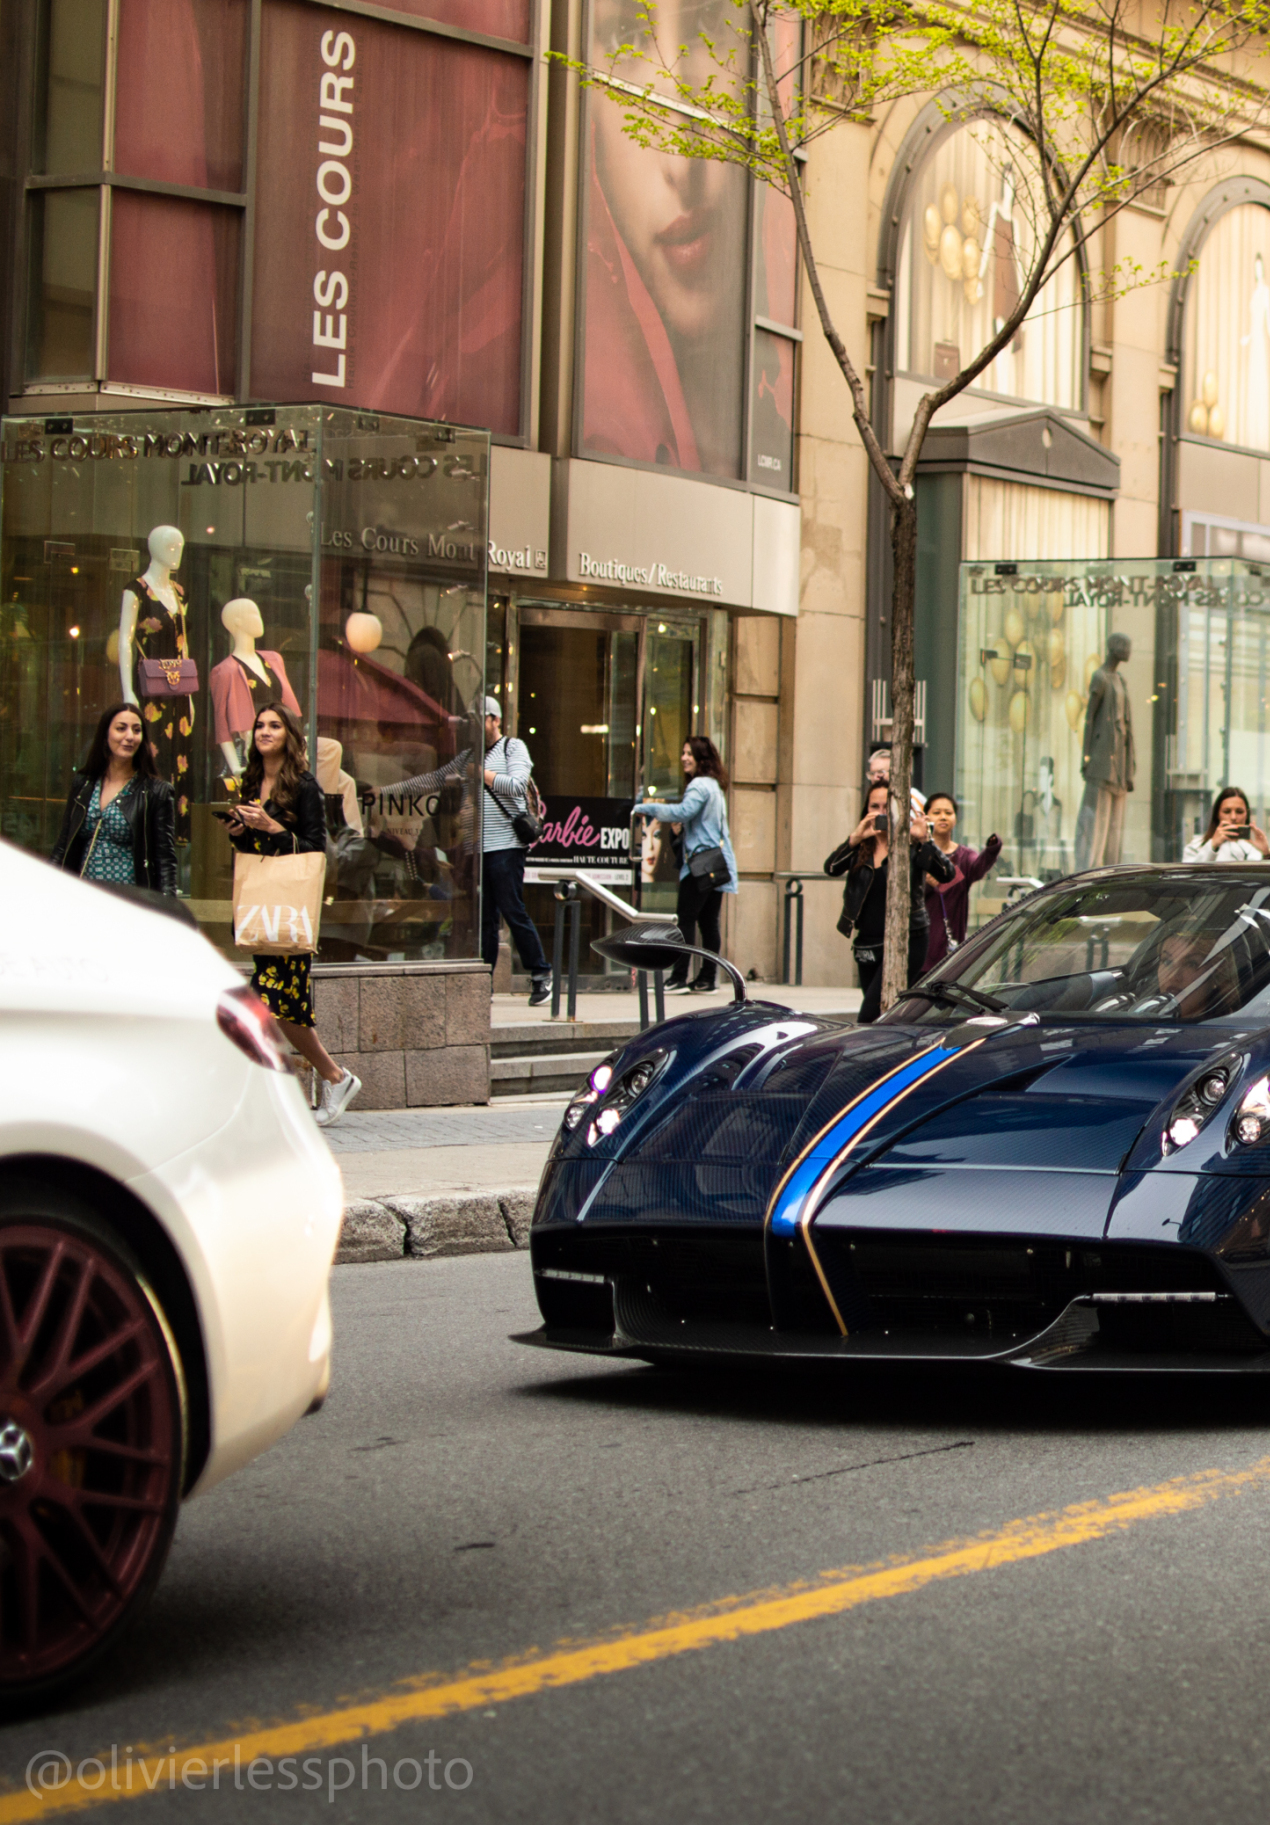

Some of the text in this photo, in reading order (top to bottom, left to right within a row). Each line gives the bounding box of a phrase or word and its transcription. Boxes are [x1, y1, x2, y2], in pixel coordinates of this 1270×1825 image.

[312, 29, 356, 388] LES COURS
[2, 439, 45, 463] LES
[53, 434, 139, 461] COURS
[320, 522, 531, 572] Les Cours Mont Royal
[579, 552, 723, 596] Boutiques/Restaurants
[971, 577, 1006, 595] LES
[361, 793, 442, 817] PINKO
[601, 827, 630, 850] EXPO
[235, 904, 314, 945] ZARA
